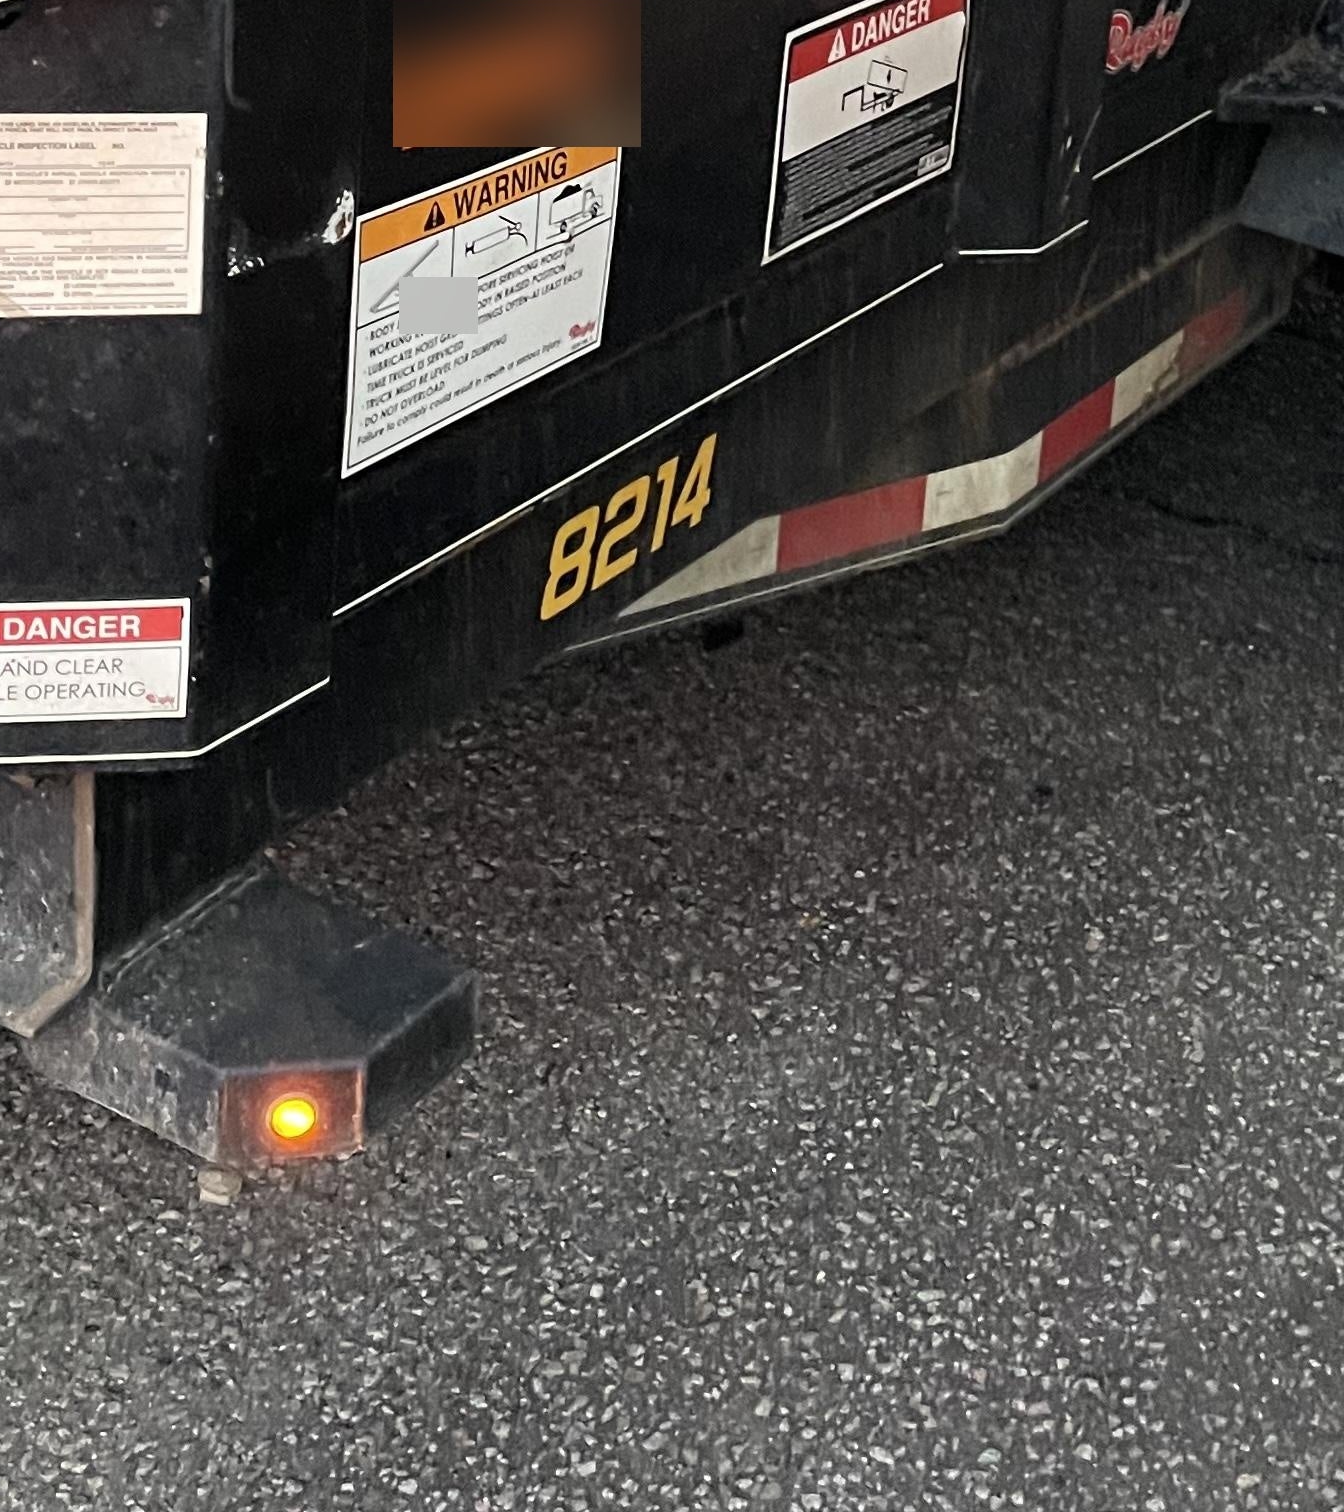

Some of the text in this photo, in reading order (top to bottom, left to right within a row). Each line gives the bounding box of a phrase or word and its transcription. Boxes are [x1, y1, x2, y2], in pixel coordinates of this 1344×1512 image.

[17, 142, 67, 150] INSPECTION
[454, 151, 567, 219] WARNING
[540, 432, 717, 621] 8214
[3, 614, 141, 640] DANGER
[55, 658, 123, 675] CLEAR
[24, 680, 145, 701] OPERATING
